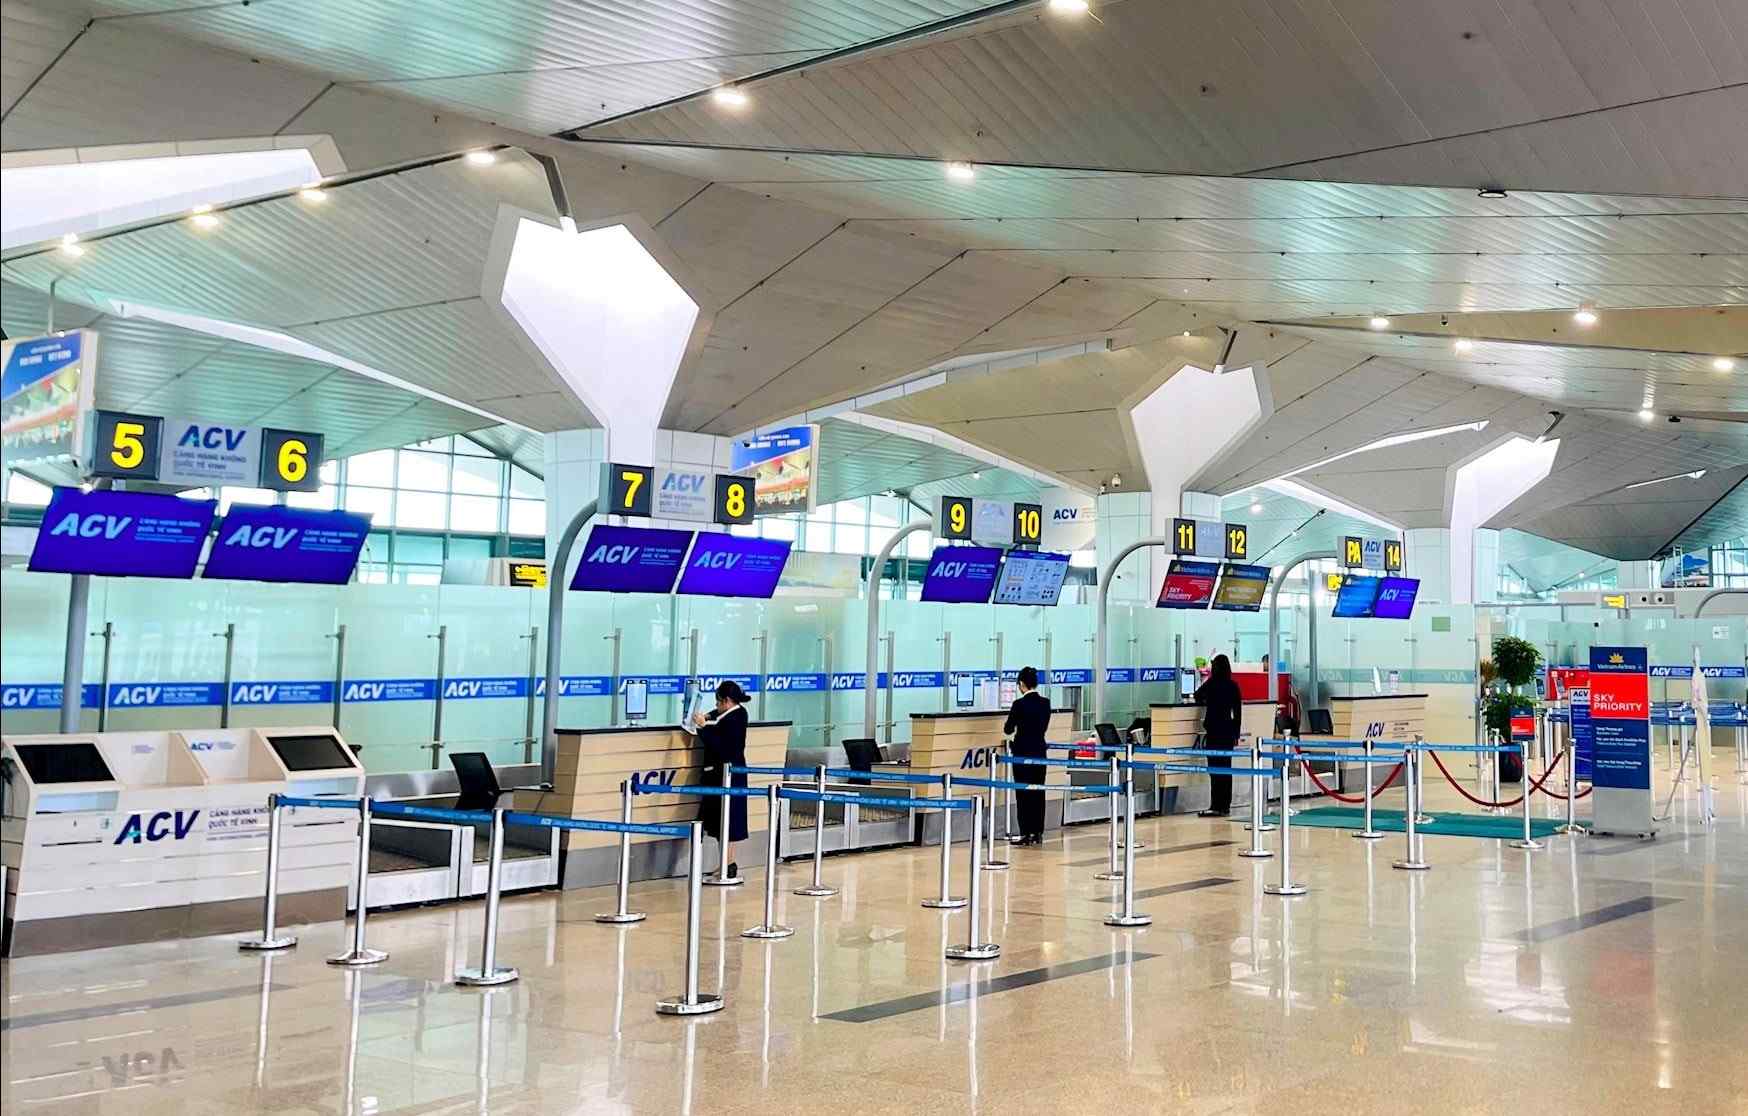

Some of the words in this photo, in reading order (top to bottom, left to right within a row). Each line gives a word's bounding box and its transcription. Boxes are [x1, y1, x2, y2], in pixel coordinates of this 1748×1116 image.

[111, 422, 145, 469] 5
[178, 425, 246, 451] ACV
[277, 440, 308, 482] 6
[622, 471, 644, 508] 7
[662, 471, 705, 492] ACV
[725, 483, 745, 517] 8
[949, 502, 966, 533] 9
[1053, 508, 1078, 520] ACV
[50, 512, 132, 539] ACV
[1017, 509, 1040, 539] 10
[225, 525, 298, 549] ACV
[1178, 524, 1193, 550] 11
[1230, 529, 1245, 554] 12
[1364, 540, 1381, 552] ACV
[587, 545, 639, 564] ACV
[694, 551, 741, 569] ACV
[1387, 544, 1400, 567] 14
[931, 561, 967, 578] ACV
[1380, 589, 1400, 601] ACV
[893, 674, 913, 687] ACV
[1143, 669, 1158, 680] ACV
[1652, 667, 1671, 676] ACV
[345, 683, 384, 700] ACV
[445, 681, 481, 697] ACV
[766, 676, 791, 690] ACV
[832, 675, 854, 689] ACV
[1, 687, 35, 706] CV
[113, 686, 161, 705] ACV
[233, 685, 277, 702] ACV
[1593, 694, 1615, 702] SKY
[1593, 702, 1642, 712] PRIORITY
[1365, 722, 1384, 738] ACV
[114, 809, 200, 845] ACV
